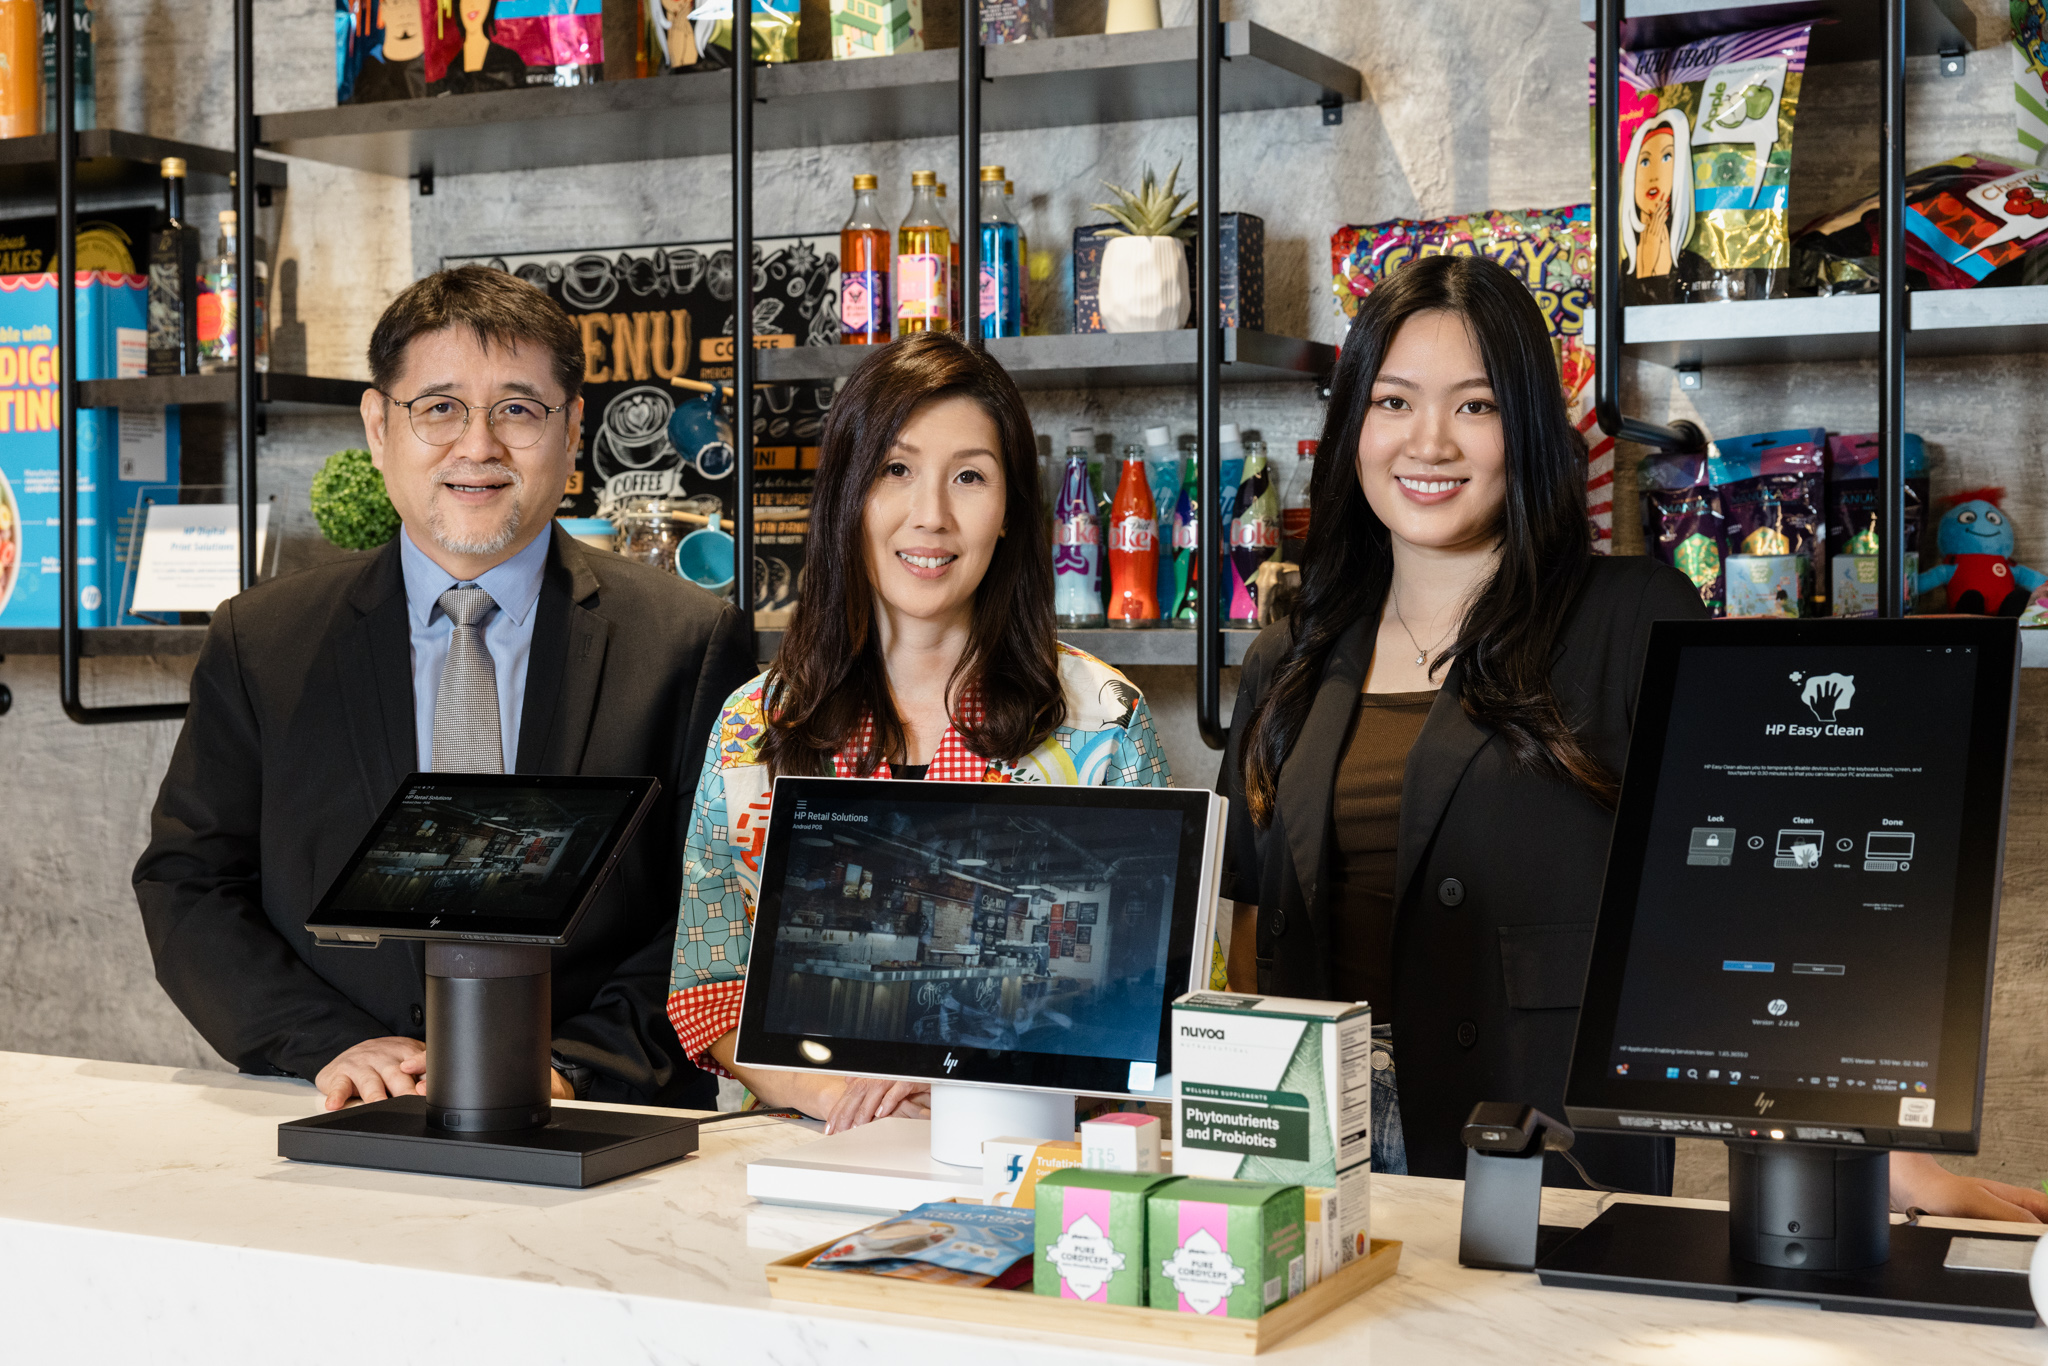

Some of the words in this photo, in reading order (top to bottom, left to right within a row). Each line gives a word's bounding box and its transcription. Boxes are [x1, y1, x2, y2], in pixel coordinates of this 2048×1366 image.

[1702, 82, 1727, 132] Apple
[1982, 174, 2039, 200] Cherry
[0, 249, 42, 273] AKES
[1384, 240, 1557, 289] CZY
[570, 309, 692, 384] ENU
[613, 473, 664, 496] COFFEE
[199, 526, 227, 537] Digital
[1108, 519, 1150, 548] oke
[1231, 517, 1280, 547] Coke
[194, 543, 234, 551] Solutions
[1765, 724, 1786, 736] HP
[1788, 724, 1822, 738] Easy
[1825, 724, 1864, 736] Clean
[794, 811, 806, 820] HP
[808, 812, 830, 820] Retail
[831, 812, 868, 822] Solutions
[1707, 815, 1724, 823] Lock
[1882, 818, 1903, 826] Done
[1770, 1000, 1786, 1016] hp
[1181, 1026, 1225, 1040] nuvoa
[1185, 1087, 1219, 1096] WELLNESS
[1221, 1090, 1268, 1101] SUPPLEMENTS
[1186, 1108, 1280, 1130] Phytonutrients
[1186, 1127, 1210, 1140] and
[1213, 1128, 1277, 1149] Probiotics
[1074, 1246, 1095, 1254] PURE
[1061, 1253, 1108, 1265] CORDYCEPS
[1191, 1260, 1213, 1269] PURE
[1178, 1268, 1228, 1280] CORDYCEPS
